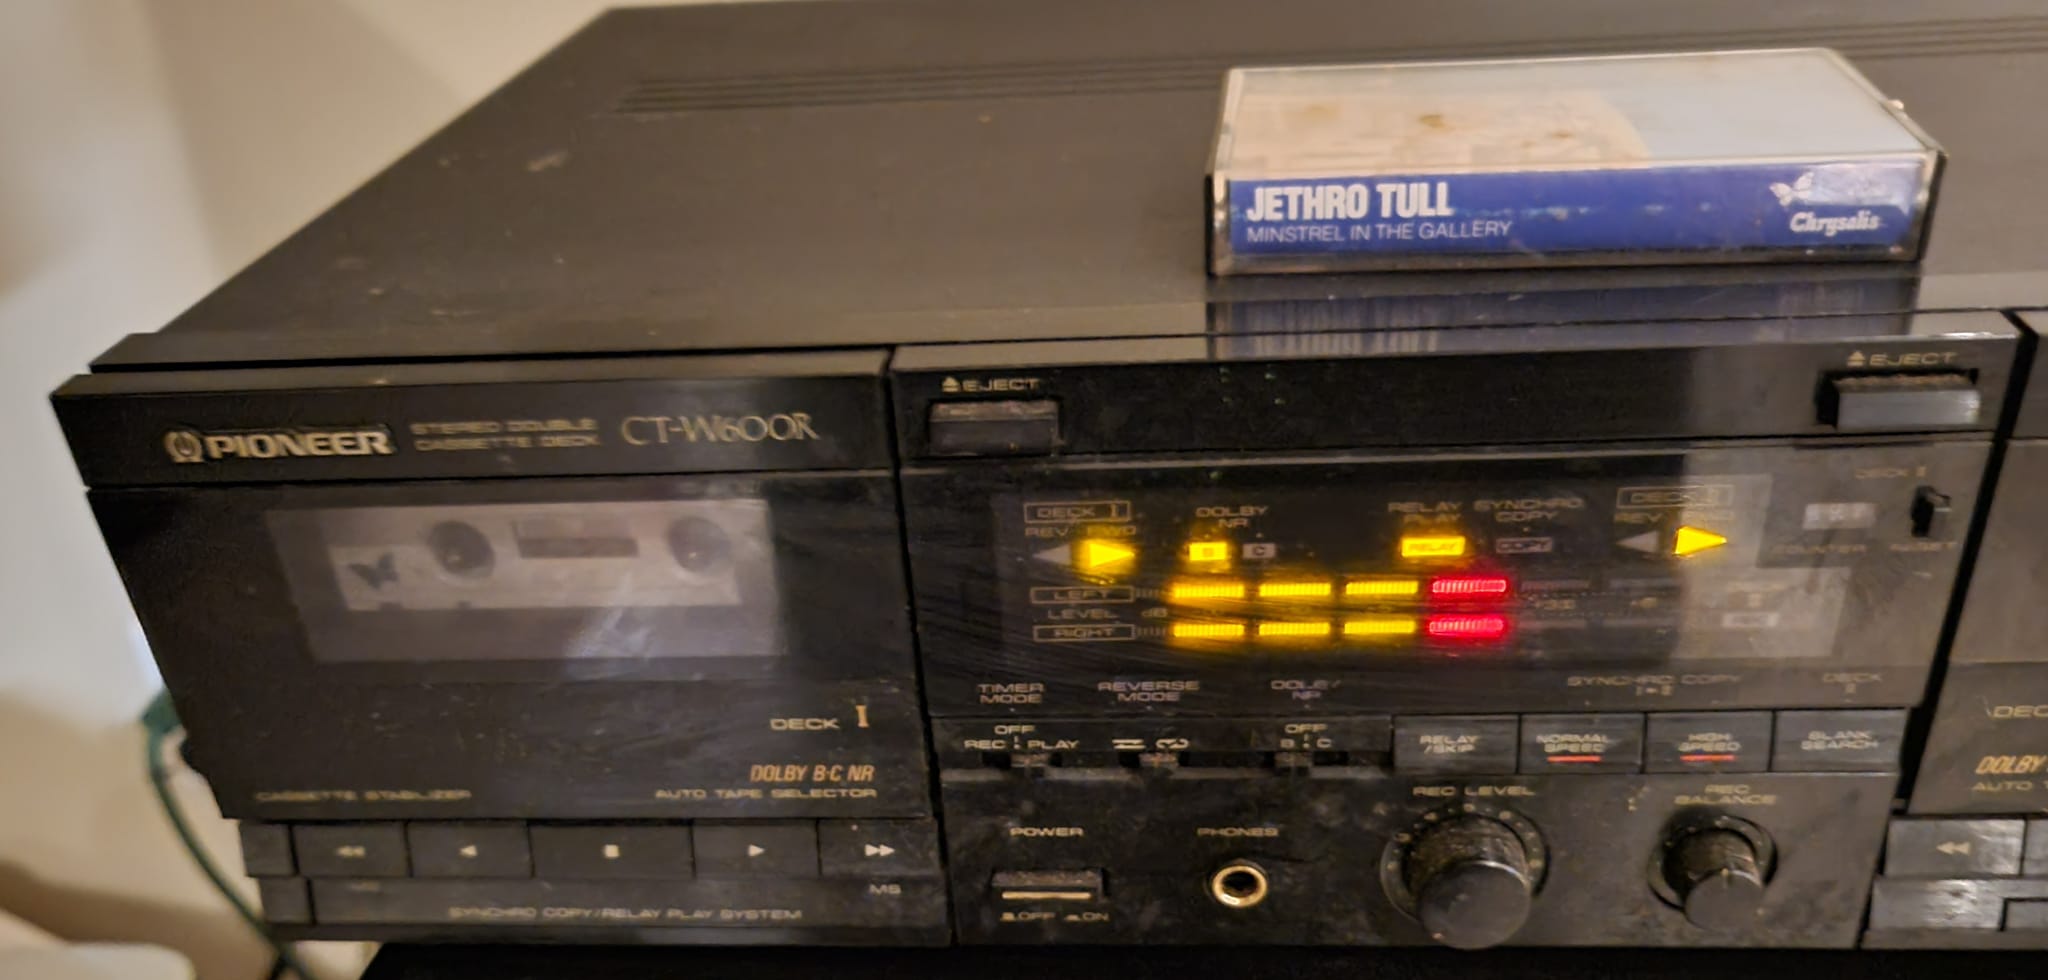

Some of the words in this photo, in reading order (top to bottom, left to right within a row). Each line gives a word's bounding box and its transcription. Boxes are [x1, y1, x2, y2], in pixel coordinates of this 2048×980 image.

[1246, 184, 1370, 222] JETHRO
[1375, 182, 1455, 219] TULL
[1790, 210, 1881, 237] Chrysalis
[1247, 225, 1345, 243] MINSTREL
[1350, 224, 1371, 241] IN
[1375, 223, 1413, 240] THE
[1418, 220, 1512, 239] GALLERY
[1869, 352, 1957, 367] EJECT
[962, 378, 1040, 391] EJECT
[410, 421, 499, 435] STEREO
[506, 418, 598, 433] DOUBLE
[620, 413, 821, 446] CT-W600R
[204, 430, 396, 460] PIONEER
[541, 434, 601, 448] DECK
[1388, 501, 1463, 513] RELAY
[1473, 498, 1585, 511] SYNCHRO
[1036, 507, 1096, 519] DECK
[1195, 505, 1269, 517] DOLBY
[1495, 511, 1559, 522] COPY
[1217, 518, 1249, 528] NR
[1024, 526, 1070, 537] REV
[1053, 589, 1110, 600] LEFT
[1048, 609, 1119, 619] LEVEL
[1141, 607, 1168, 618] dB
[1053, 627, 1115, 639] RIGHT
[978, 683, 1046, 694] TIMER
[1098, 681, 1200, 691] REVERSE
[980, 694, 1043, 704] MODE
[1118, 692, 1181, 702] MODE
[1992, 705, 2048, 719] DEC
[770, 718, 841, 730] DECK
[1284, 724, 1328, 734] OFF
[994, 725, 1036, 735] OFF
[1419, 735, 1480, 745] RELAY
[1536, 733, 1610, 744] NORMAL
[964, 739, 1006, 749] REC
[1027, 739, 1080, 750] PLAY
[1544, 743, 1606, 753] SPEED
[1678, 741, 1742, 751] SPEED
[1801, 740, 1880, 751] SEARCH
[1975, 755, 2048, 774] DOLBY
[750, 764, 809, 782] DOLBY
[846, 764, 876, 782] NR
[1412, 786, 1457, 797] REC
[1463, 785, 1537, 797] LEVEL
[1705, 784, 1750, 794] REC
[1972, 781, 2033, 792] AUTO
[655, 789, 708, 799] AUTO
[715, 789, 763, 799] TAPE
[771, 788, 878, 798] SELECTOR
[1674, 795, 1777, 805] BALANCE
[1009, 827, 1084, 838] POWER
[1198, 827, 1279, 838] PHONES
[869, 884, 902, 895] MS
[448, 906, 537, 919] SYNCHRO
[667, 907, 715, 919] PLAY
[719, 907, 803, 920] SYSTEM
